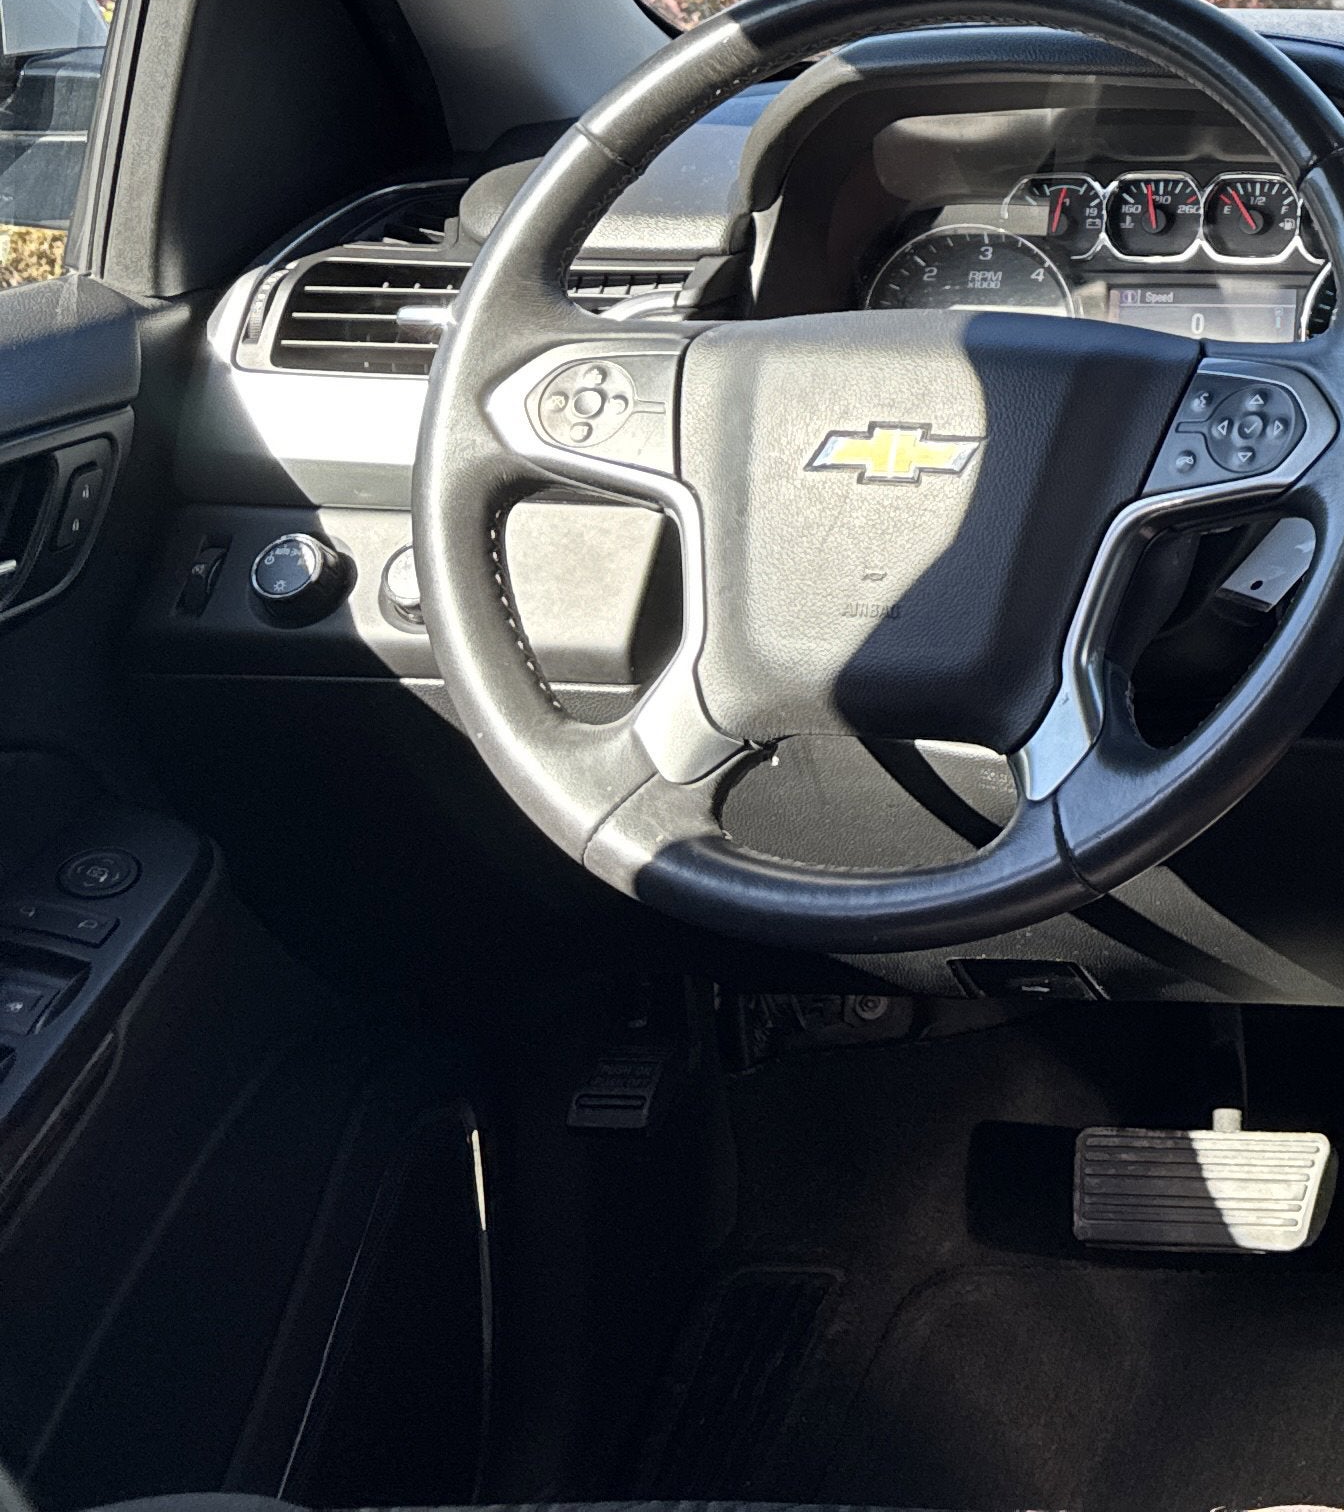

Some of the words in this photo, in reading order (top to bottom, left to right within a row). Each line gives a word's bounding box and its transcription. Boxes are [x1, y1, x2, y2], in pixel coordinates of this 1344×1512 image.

[1250, 196, 1265, 206] 1/2
[1085, 207, 1098, 217] 19
[1122, 204, 1142, 214] 160
[1177, 205, 1200, 214] 260
[1224, 205, 1231, 215] E
[1281, 205, 1289, 215] F
[979, 246, 993, 260] 3
[923, 267, 937, 281] 2
[968, 272, 1002, 280] RPM
[1030, 268, 1044, 282] 4
[1146, 292, 1174, 303] Speed
[1191, 313, 1204, 334] 0
